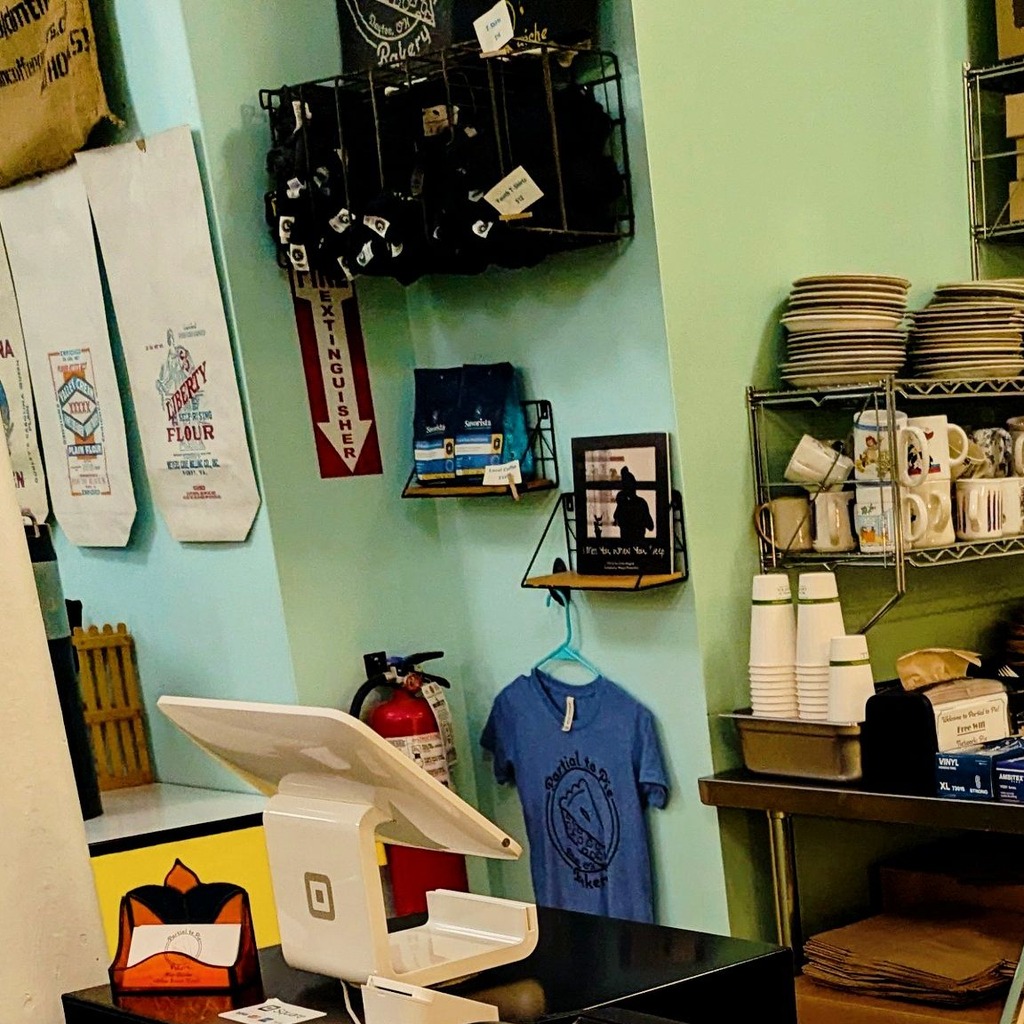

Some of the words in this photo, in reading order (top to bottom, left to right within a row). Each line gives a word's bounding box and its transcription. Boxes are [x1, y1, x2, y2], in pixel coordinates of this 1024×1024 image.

[319, 290, 356, 459] EXTINGUISHER
[165, 361, 208, 420] LIBERTY
[166, 424, 215, 443] FLOUR
[957, 725, 971, 734] Free
[938, 757, 960, 767] VINYL
[545, 750, 581, 790] Partial
[584, 756, 597, 772] to
[598, 768, 614, 799] Pie
[998, 773, 1024, 782] AMBITEX
[939, 781, 951, 790] XL
